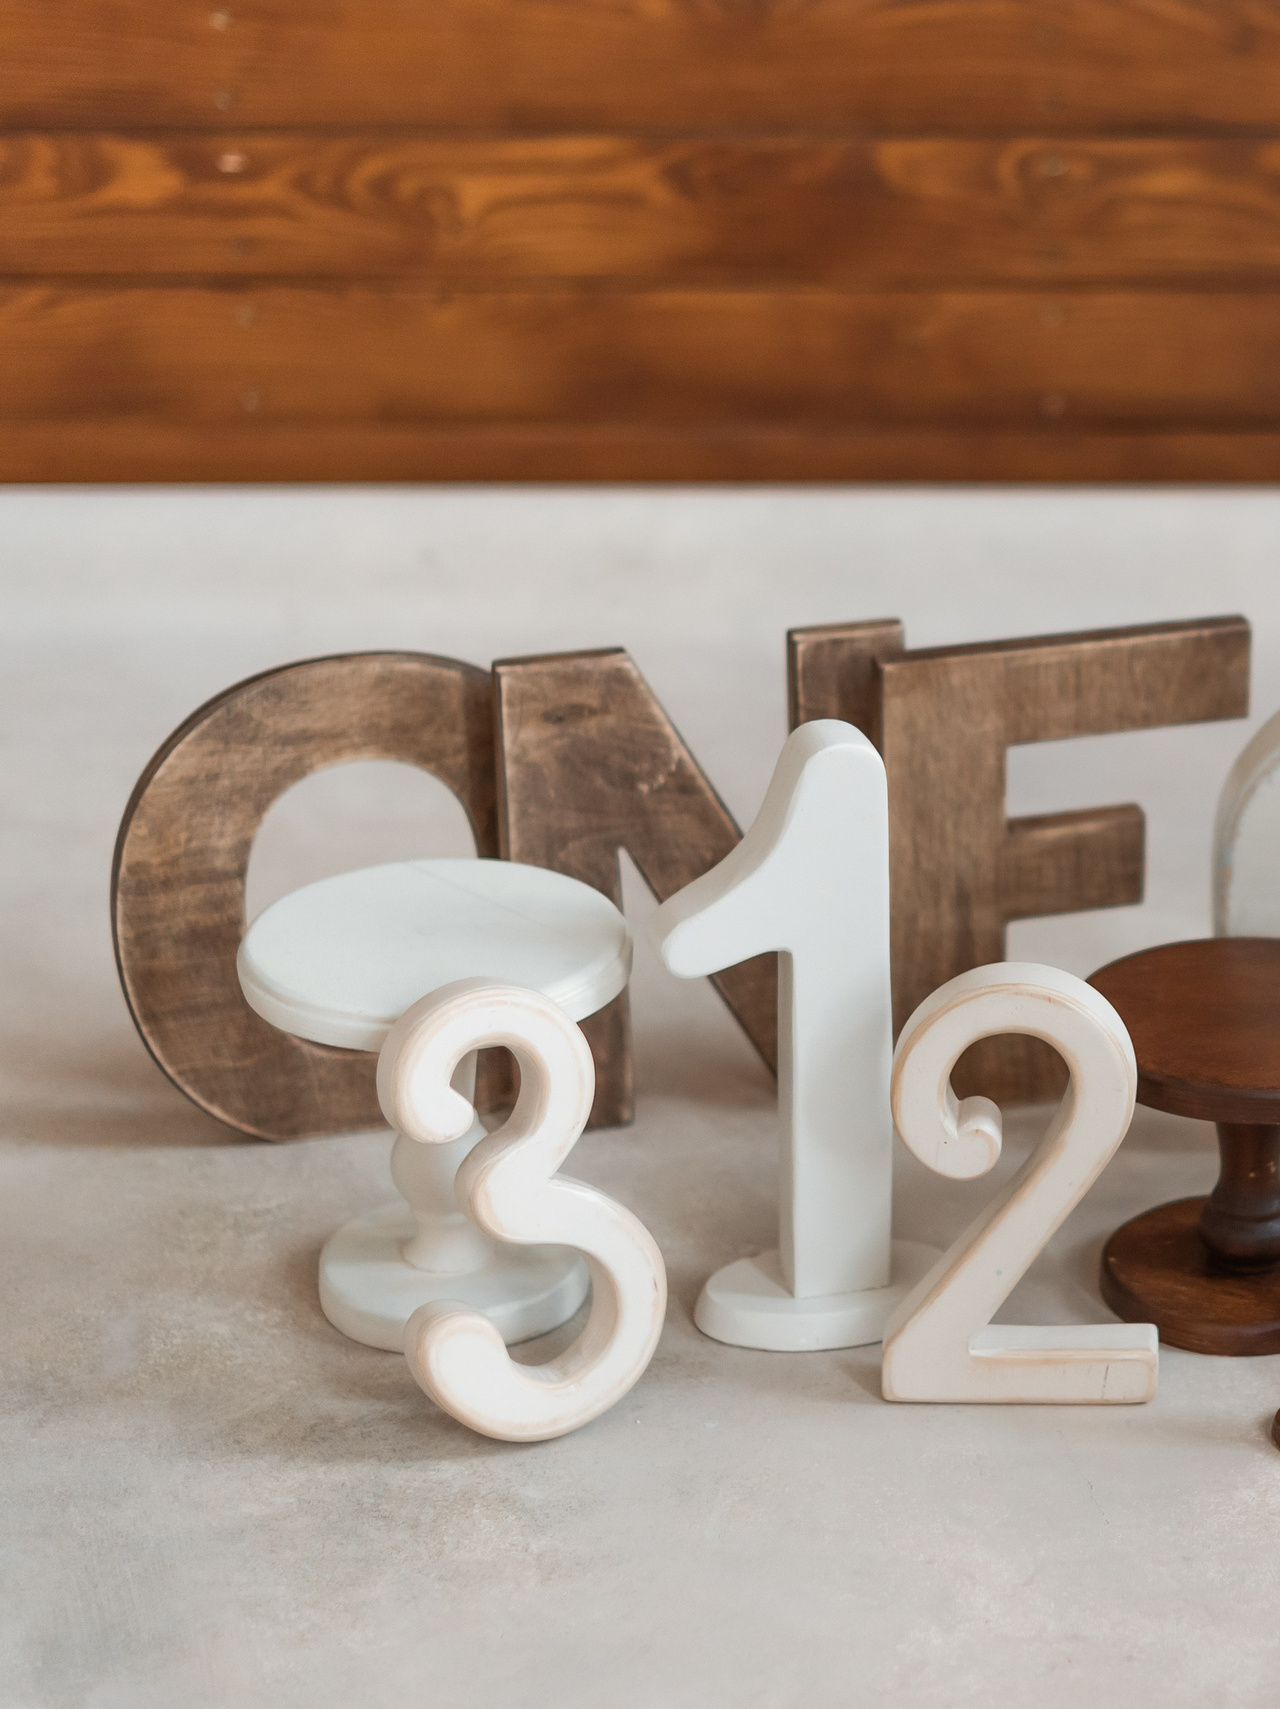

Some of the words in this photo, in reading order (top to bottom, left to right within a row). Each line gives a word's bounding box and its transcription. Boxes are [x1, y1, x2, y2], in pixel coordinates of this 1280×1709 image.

[376, 976, 667, 1442] 3
[661, 718, 892, 1298] 1
[882, 961, 1159, 1404] 2
